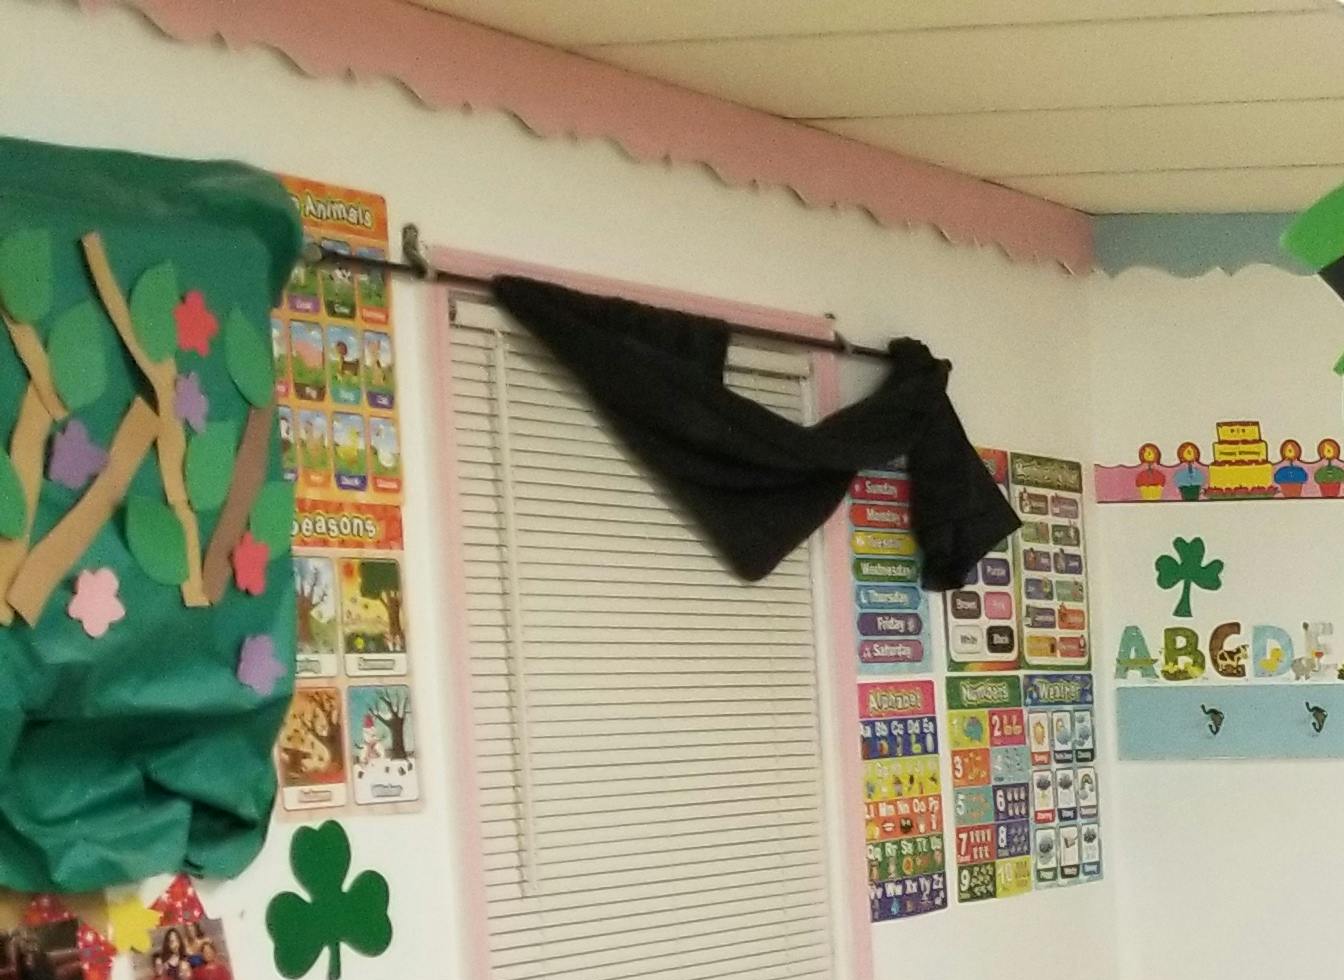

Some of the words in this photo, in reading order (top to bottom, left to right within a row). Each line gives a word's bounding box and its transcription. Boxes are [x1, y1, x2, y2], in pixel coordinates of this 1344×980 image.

[990, 717, 1003, 737] 2
[953, 755, 965, 779] 3
[995, 789, 1007, 814] 6
[957, 832, 968, 856] 7
[959, 868, 971, 893] 9
